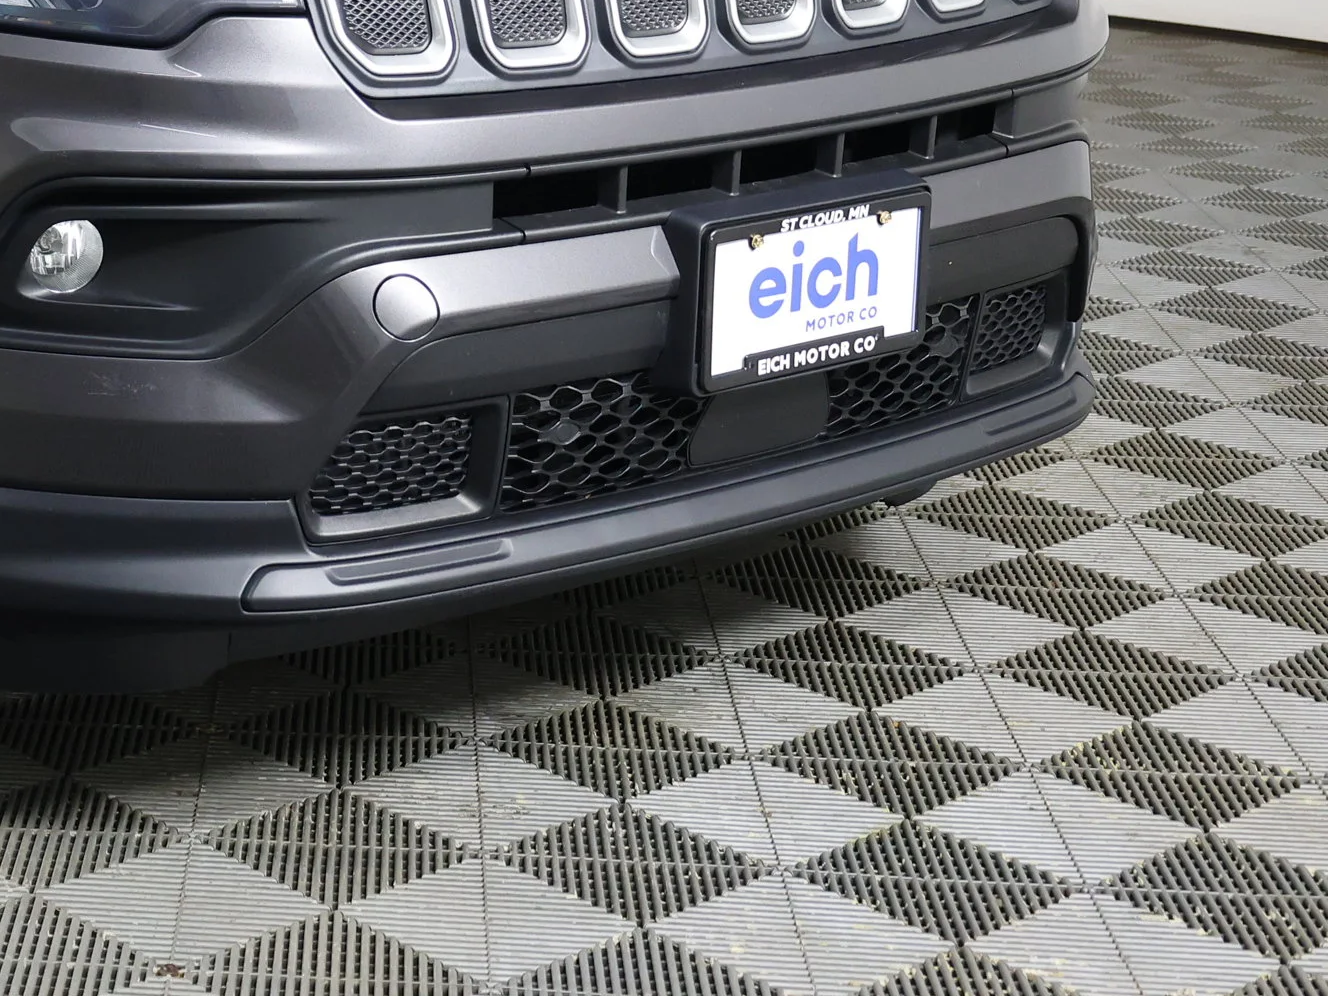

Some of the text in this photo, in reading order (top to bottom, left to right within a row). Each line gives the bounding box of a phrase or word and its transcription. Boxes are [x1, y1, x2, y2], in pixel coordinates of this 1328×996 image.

[780, 204, 870, 233] ST CLOUD, MN
[749, 233, 879, 319] eich
[805, 306, 878, 332] MOTOR CO
[757, 354, 790, 376] EICH
[793, 340, 850, 368] MOTOR
